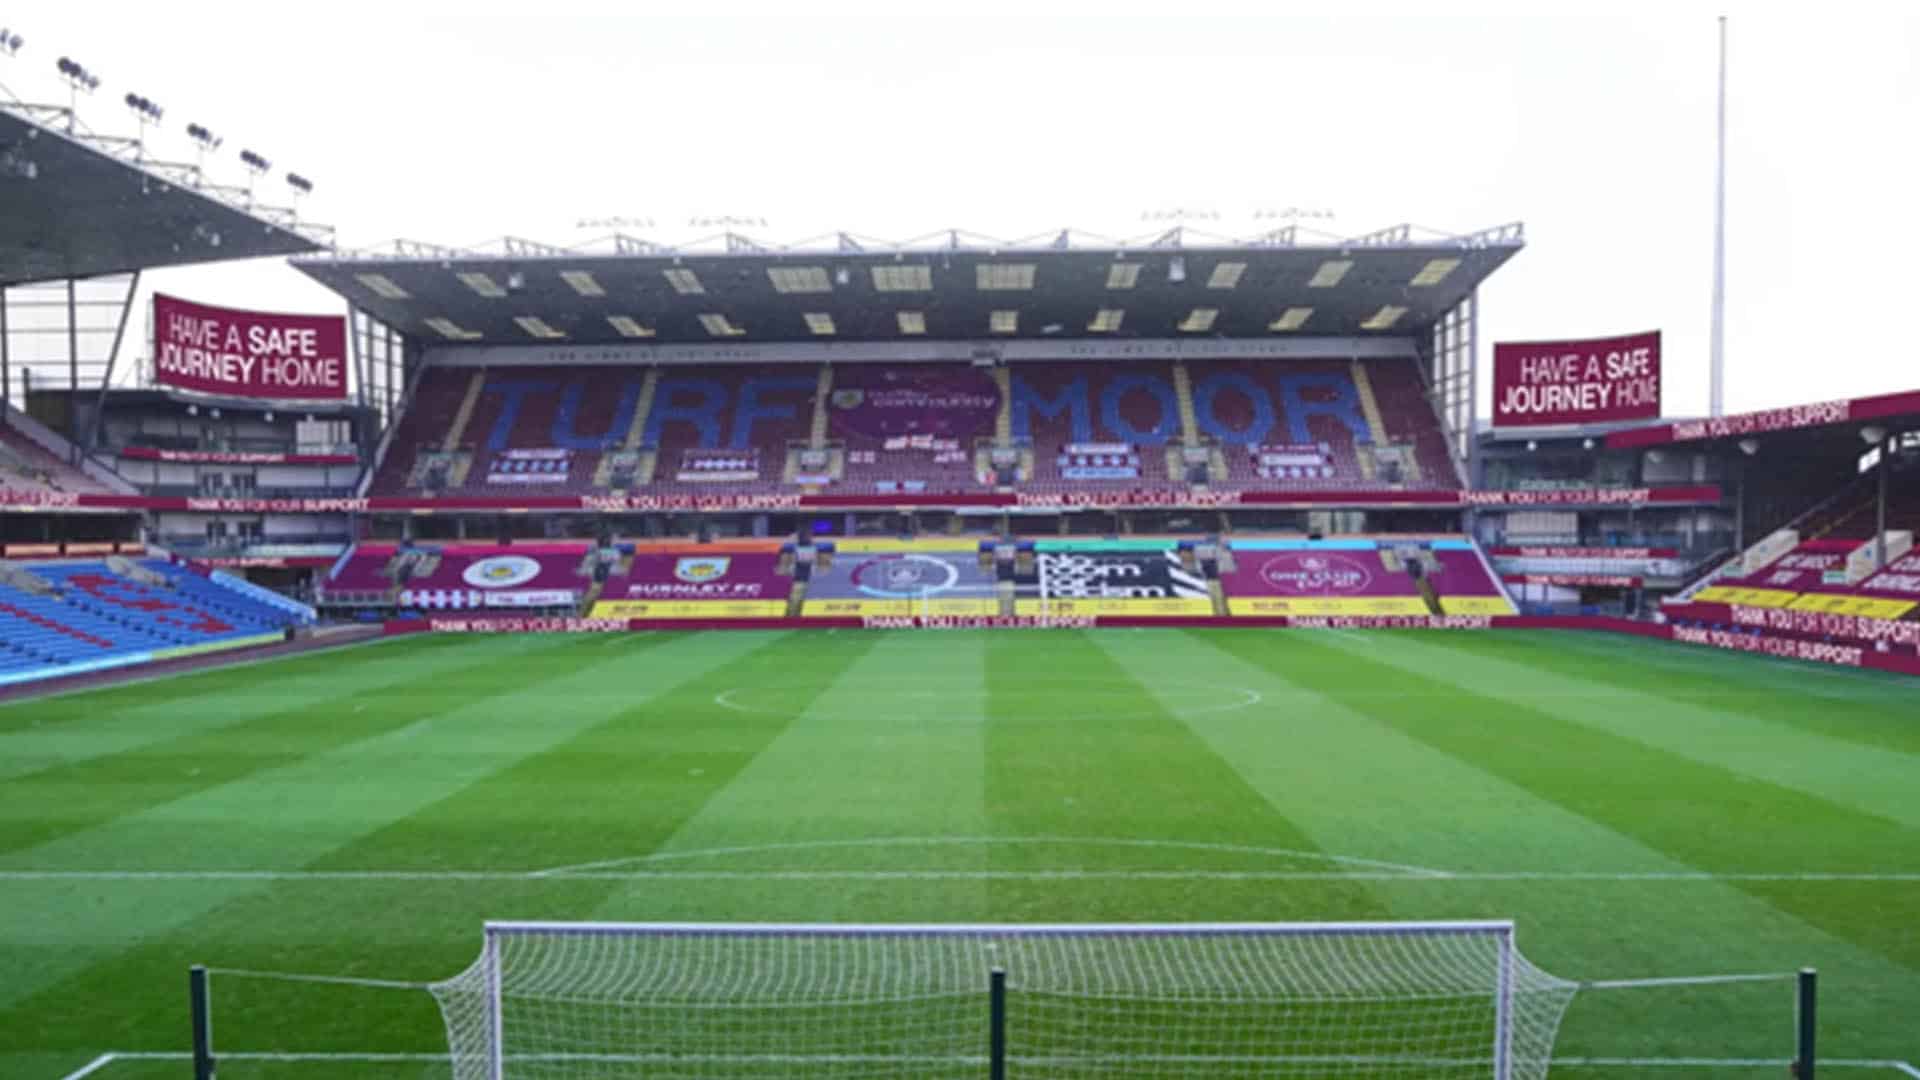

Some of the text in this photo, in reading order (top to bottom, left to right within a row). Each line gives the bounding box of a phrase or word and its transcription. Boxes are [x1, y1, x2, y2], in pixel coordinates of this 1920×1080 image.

[170, 312, 317, 360] HAVE A SAFE
[159, 343, 340, 387] JOURNEY HOME
[1521, 348, 1650, 384] HAVE A SAFE
[485, 374, 817, 450] TURF
[1010, 373, 1371, 447] MOOR
[1500, 375, 1657, 414] JOURNEY HOME
[1673, 399, 1849, 440] THANK YOU FOR YOUR SUPPORT
[271, 499, 302, 511] YOUR
[304, 499, 369, 511] SUPPORT
[582, 495, 800, 508] THANK YOU FOR YOUR SUPPORT
[1016, 493, 1240, 506] THANK YOU FOR YOUR SUPPORT
[1458, 489, 1649, 503] THANK YOU FOR YOUR SUPPORT
[628, 583, 732, 597] BURNLEY
[431, 619, 628, 631] THANK YOU FOR YOUR SUPPORT
[863, 616, 1094, 628] THANK YOU FOR YOUR SUPPORT
[1287, 616, 1490, 628] THANK YOU FOR YOUR SUPPORT
[1731, 604, 1920, 643] THANK YOU FOR YOUR SUPPORT
[1673, 625, 1861, 666] THANK YOU FOR YOUR SUPPORT
